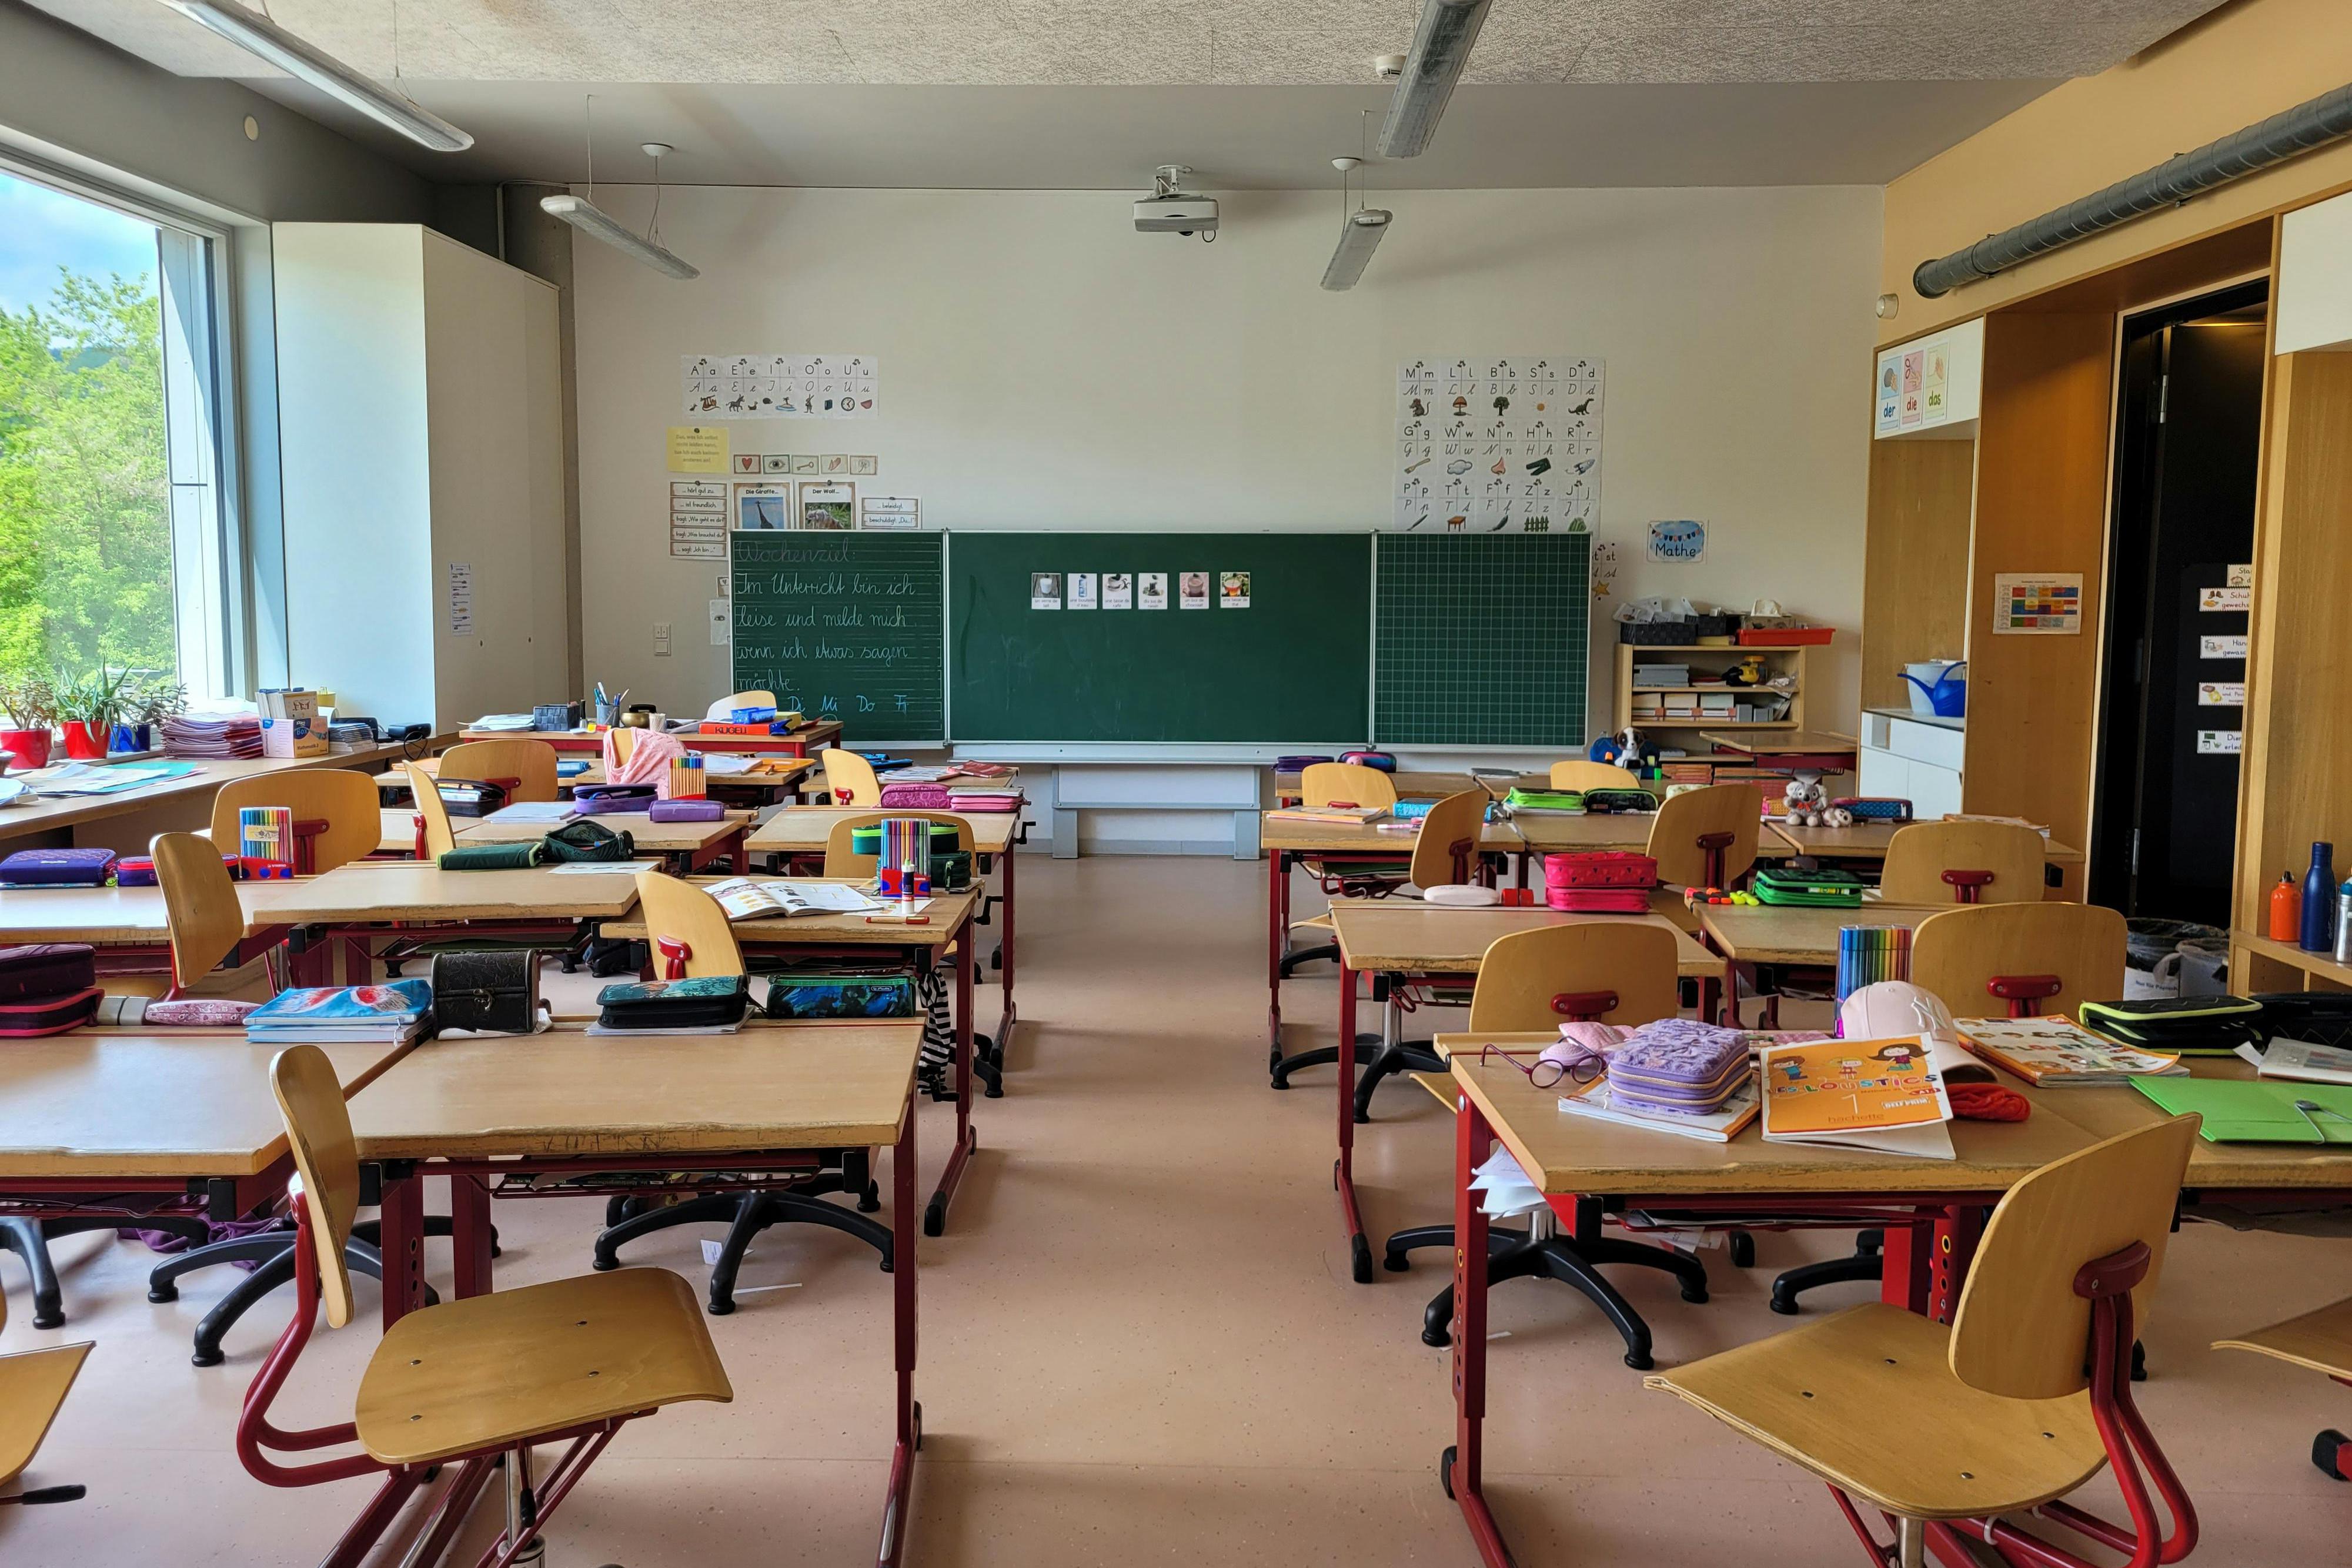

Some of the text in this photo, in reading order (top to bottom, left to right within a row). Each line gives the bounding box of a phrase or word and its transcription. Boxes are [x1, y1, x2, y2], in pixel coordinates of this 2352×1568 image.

[691, 365, 699, 376] A
[731, 365, 738, 376] E
[770, 364, 790, 375] I i
[804, 365, 814, 375] O
[844, 365, 851, 375] U
[1406, 368, 1415, 379] M
[1449, 367, 1473, 378] L l
[1491, 367, 1516, 377] B b
[1529, 367, 1537, 378] S
[1569, 367, 1595, 378] D d
[1907, 396, 1917, 411] die
[1929, 390, 1941, 407] das
[1883, 403, 1896, 417] der
[1404, 426, 1430, 440] G g
[1444, 427, 1458, 438] W
[1487, 427, 1495, 438] N
[1526, 427, 1552, 438] H h
[1568, 427, 1574, 438] R
[1404, 483, 1429, 498] P p
[1445, 484, 1469, 496] T t
[1486, 483, 1511, 494] F f
[1525, 485, 1534, 496] Z
[1566, 485, 1590, 500] J j
[1655, 543, 1696, 557] Mathe
[1606, 551, 1615, 561] st
[771, 572, 845, 596] Unterricht
[852, 573, 881, 594] bin
[886, 573, 916, 596] ich
[738, 604, 776, 627] leise
[785, 605, 816, 627] und
[823, 604, 864, 627] melde
[737, 636, 908, 667] wenn ich etwas sagen
[787, 696, 806, 712] Di
[820, 696, 838, 712] Mi
[856, 695, 875, 711] Do
